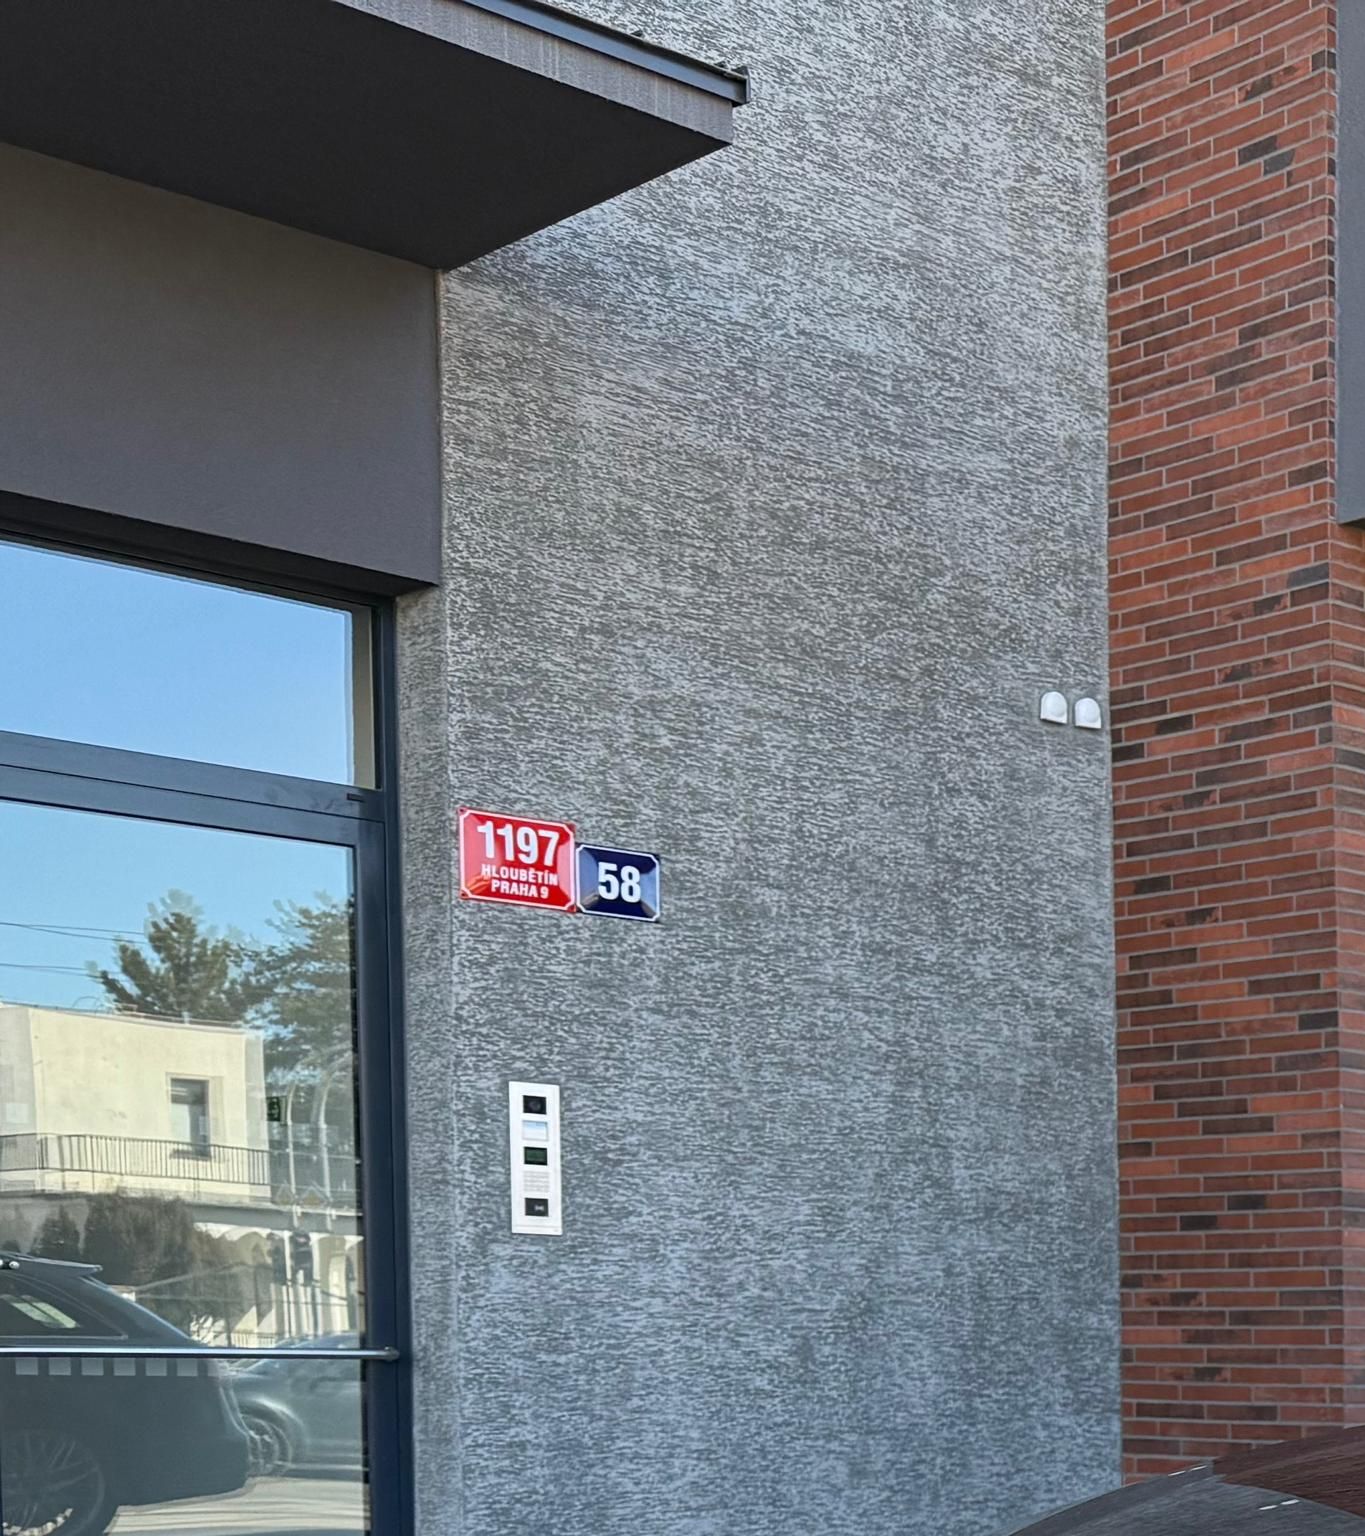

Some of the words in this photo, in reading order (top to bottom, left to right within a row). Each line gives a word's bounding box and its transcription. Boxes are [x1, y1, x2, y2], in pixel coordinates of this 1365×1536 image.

[477, 821, 560, 867] 1197
[481, 864, 558, 886] HLOUBĚTÍN
[491, 879, 538, 897] PRAHA
[540, 888, 549, 899] 9
[597, 862, 641, 903] 58
